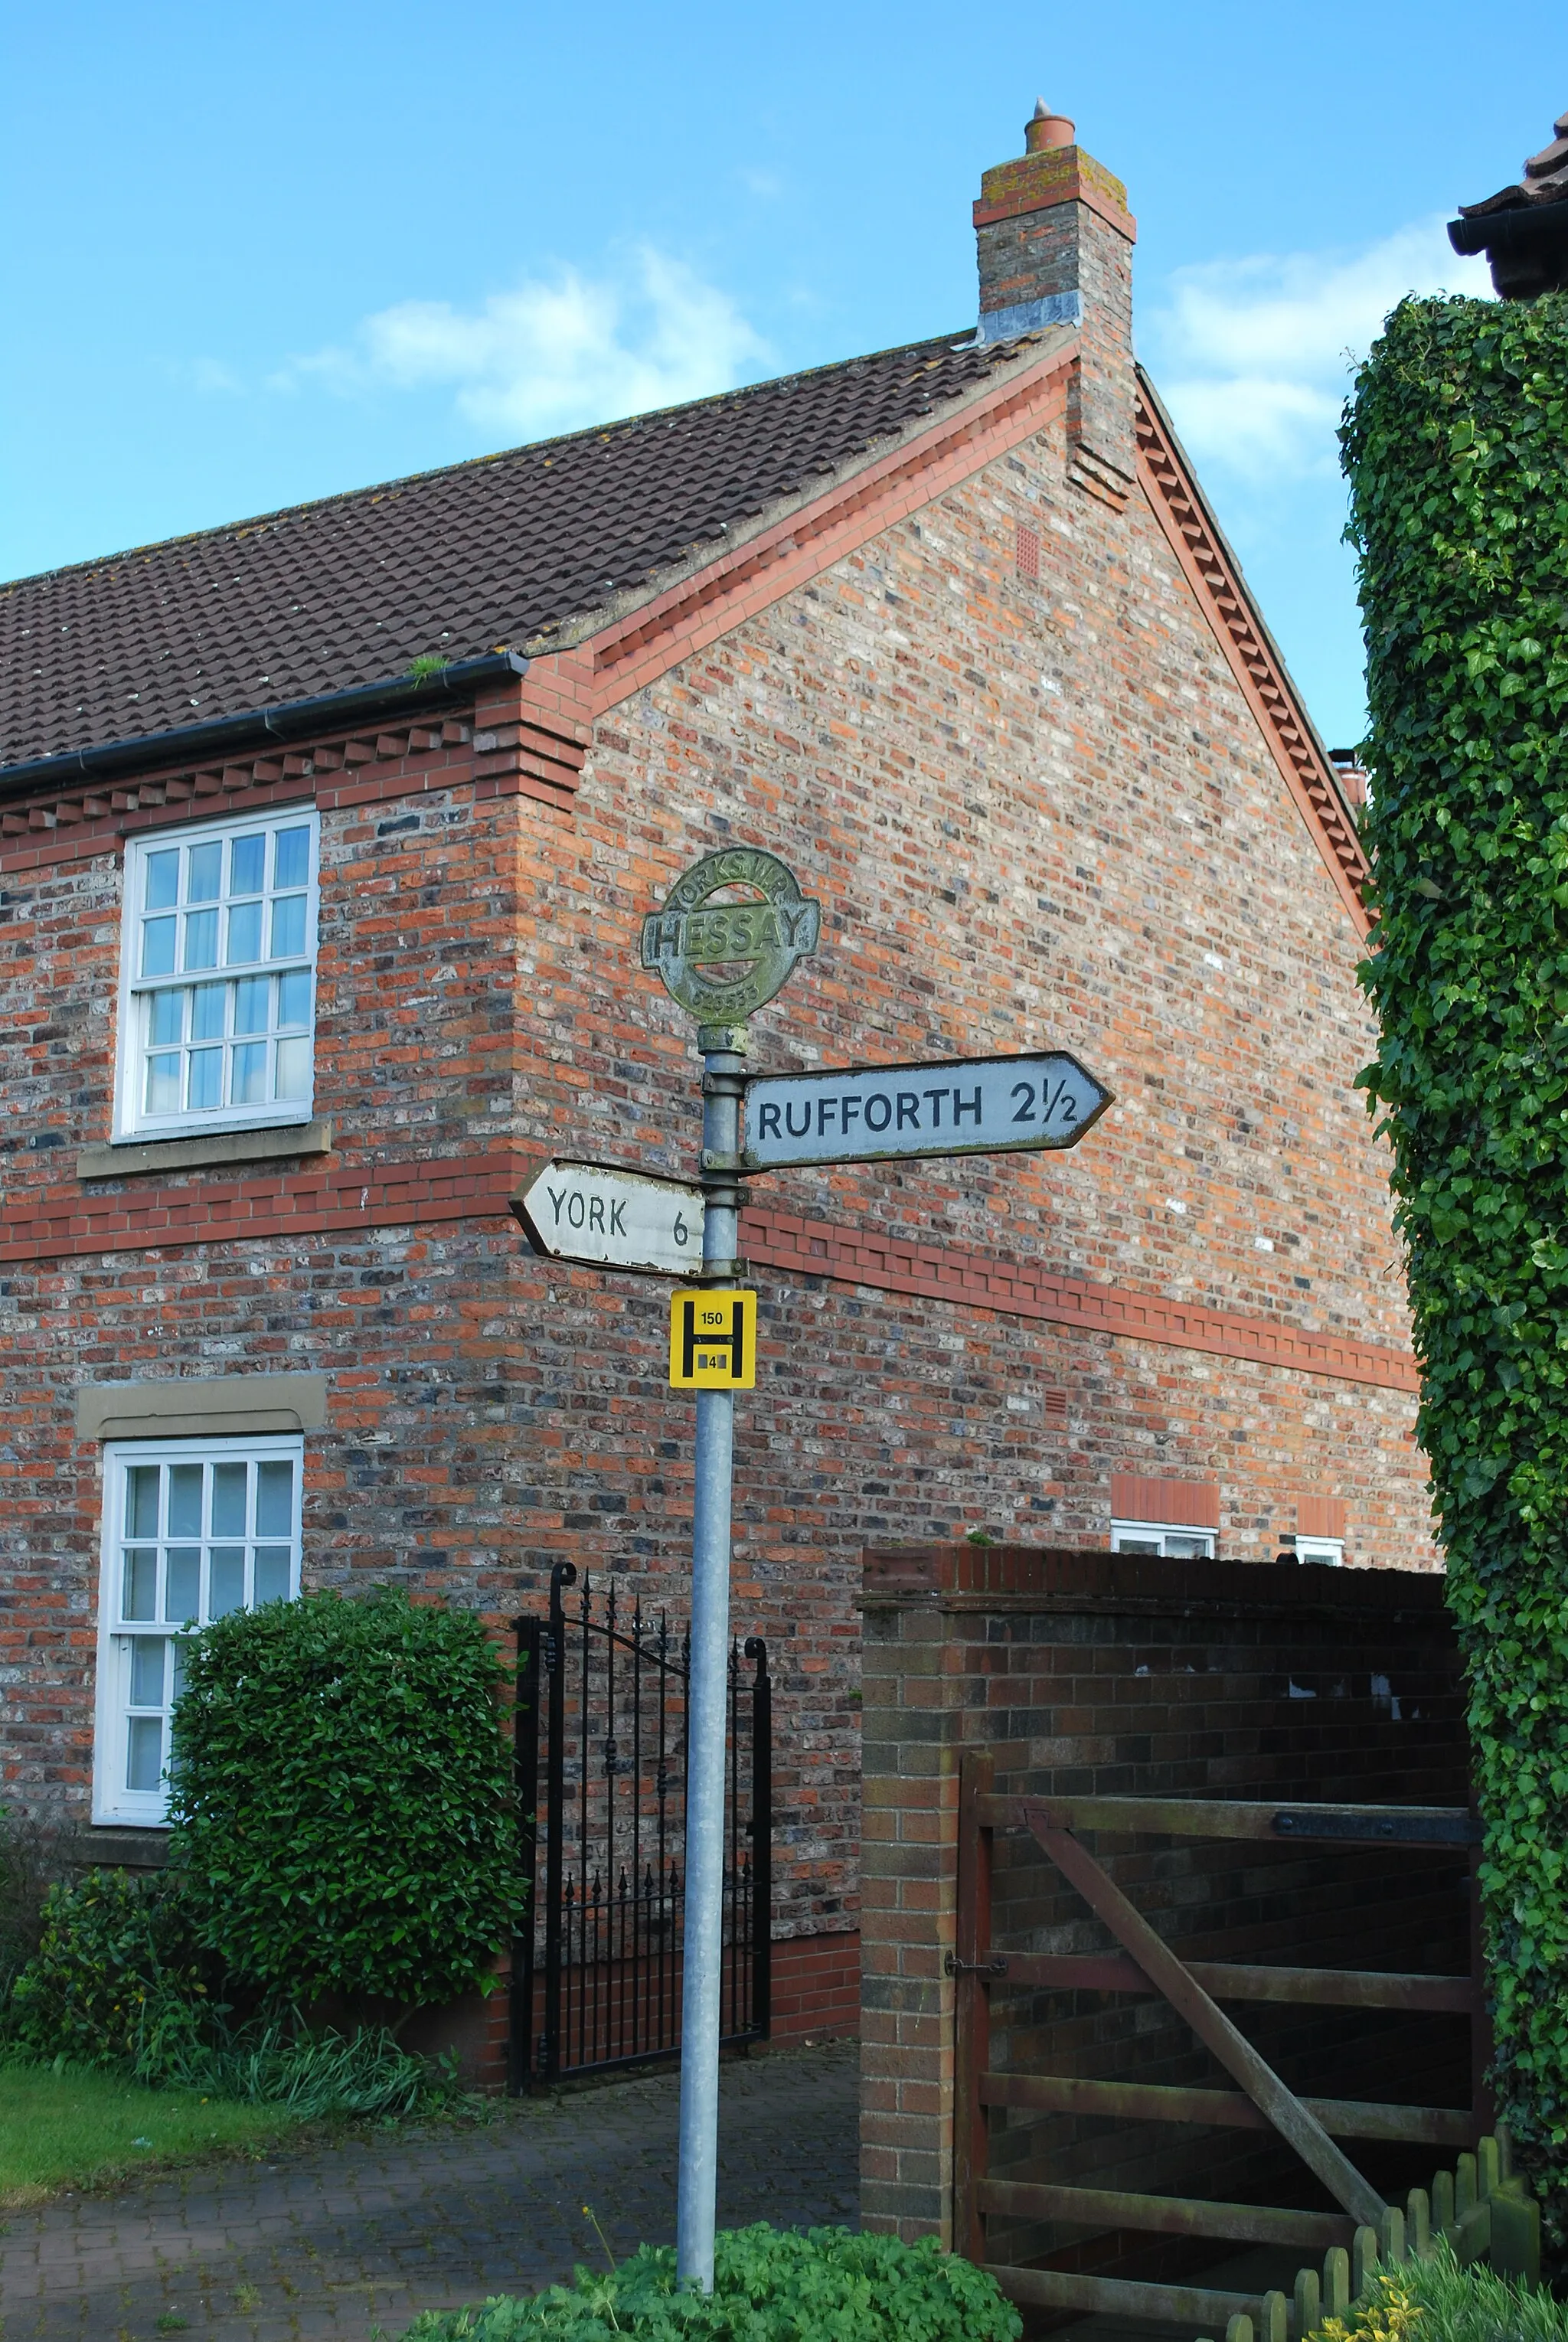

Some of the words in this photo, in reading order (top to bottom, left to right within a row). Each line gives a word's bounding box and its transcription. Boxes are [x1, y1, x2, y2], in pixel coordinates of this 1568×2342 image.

[655, 908, 806, 957] HESSAY
[759, 1086, 982, 1140] RUFFORTH
[547, 1187, 627, 1236] YORK
[674, 1211, 688, 1246] 6
[682, 1301, 743, 1378] H
[701, 1311, 723, 1325] 150
[709, 1356, 717, 1368] 4
